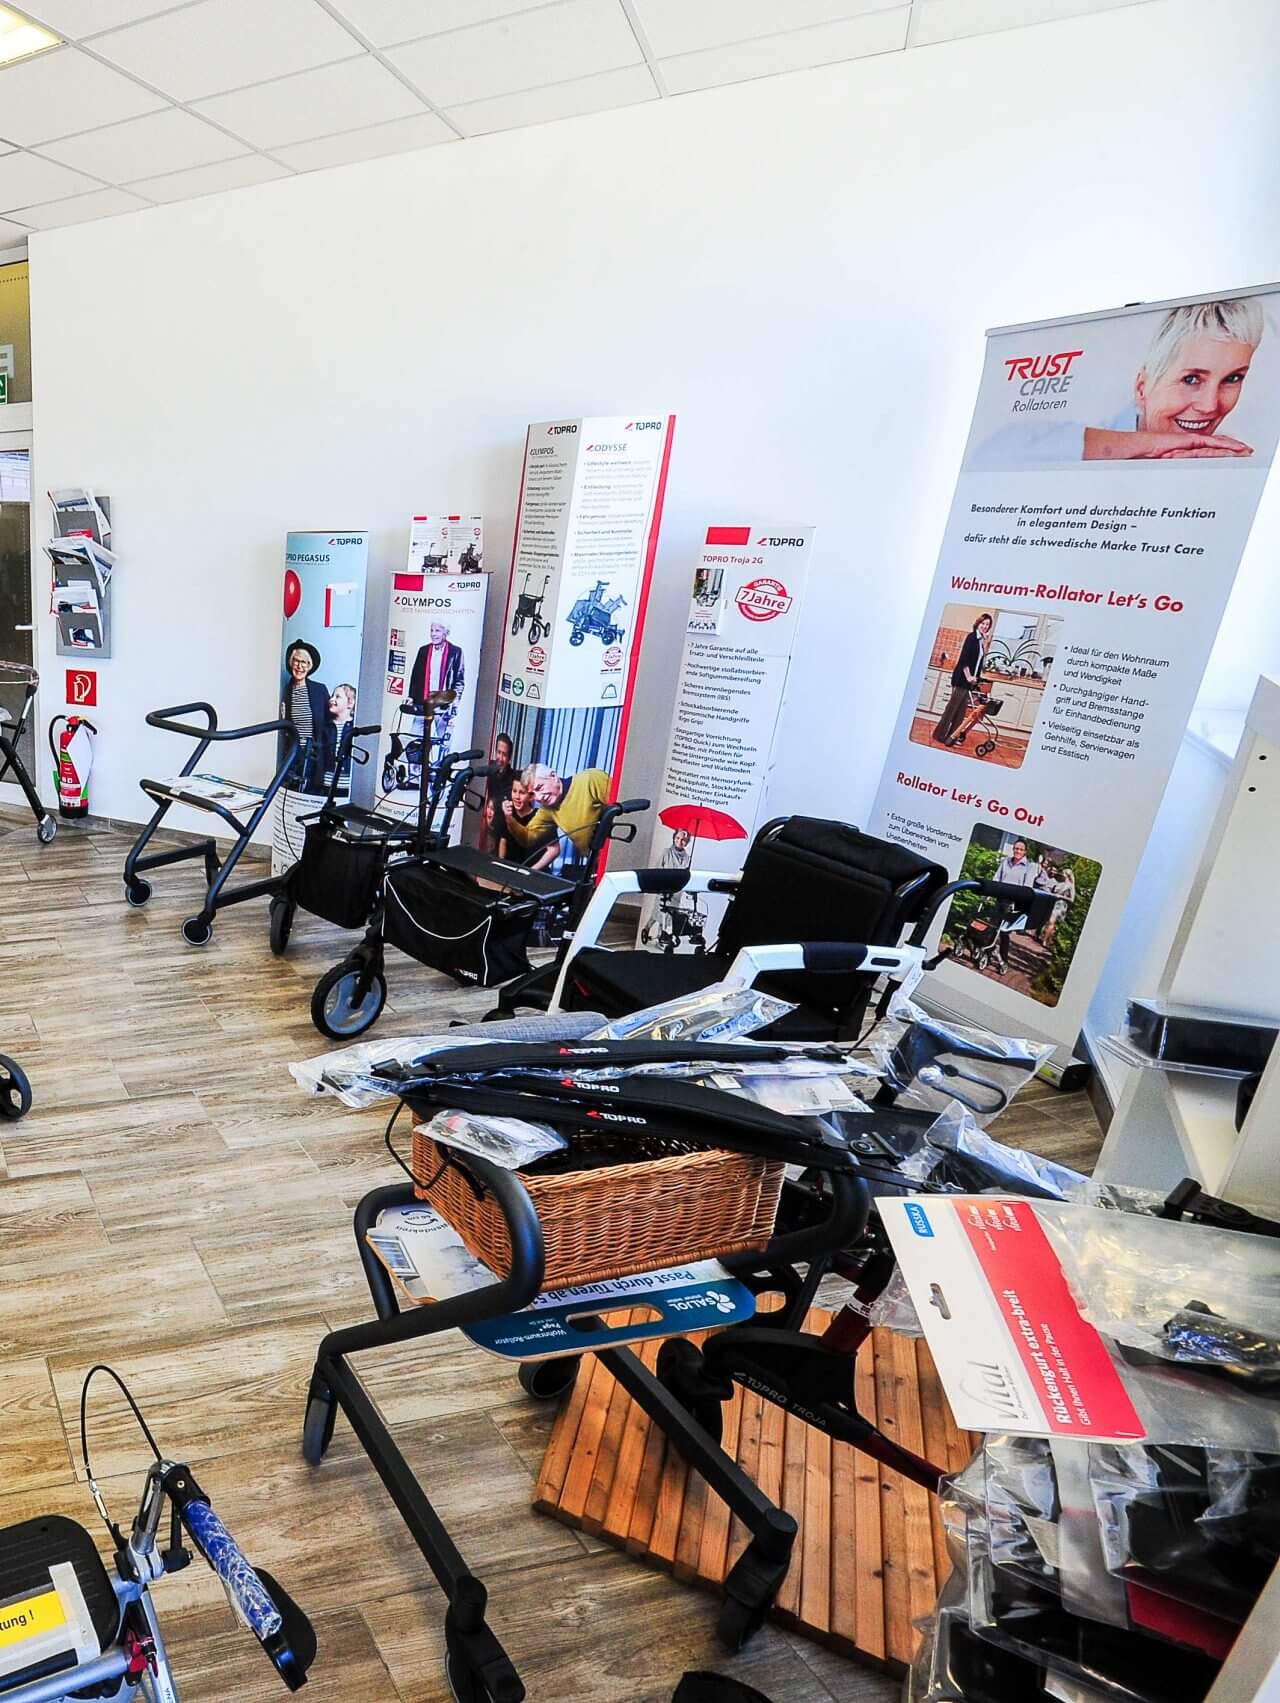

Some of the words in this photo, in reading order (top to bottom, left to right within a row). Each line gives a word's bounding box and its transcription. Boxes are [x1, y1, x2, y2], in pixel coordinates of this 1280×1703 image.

[1005, 351, 1083, 381] TRUST
[1019, 376, 1073, 396] CARE
[1012, 398, 1067, 413] Rollatoren
[554, 425, 577, 434] TOPRO
[635, 422, 662, 431] TOPRO
[971, 504, 1018, 516] Besonderer
[1020, 503, 1062, 516] Komfort
[1065, 505, 1086, 516] und
[1090, 505, 1158, 519] durchdachte
[1161, 508, 1216, 520] Funktion
[1017, 518, 1026, 527] in
[1029, 519, 1087, 532] elegantem
[1090, 521, 1127, 533] Design
[768, 538, 804, 547] TOPRO
[964, 532, 986, 545] dafür
[989, 535, 1009, 545] steht
[1011, 536, 1027, 547] die
[1030, 536, 1097, 551] schwedische
[1101, 540, 1136, 553] Marke
[1141, 543, 1170, 554] Trust
[1173, 544, 1204, 556] Care
[703, 555, 728, 563] TOPRO
[401, 596, 452, 607] OLYMPOS
[951, 575, 1103, 605] Wohnraum-Rollator
[1154, 595, 1184, 614] Go
[1070, 645, 1089, 655] Ideal
[1091, 648, 1102, 657] für
[1103, 651, 1119, 661] den
[1121, 652, 1169, 668] Wohnraum
[1067, 658, 1089, 668] durch
[1091, 660, 1130, 675] kompakte
[1132, 669, 1158, 679] Maße
[1064, 670, 1079, 678] und
[1080, 672, 1122, 686] Wendigkeit
[1059, 683, 1119, 702] Durchgängiger
[1121, 695, 1150, 707] Hand-
[1055, 696, 1071, 705] griff
[1072, 699, 1087, 708] und
[1088, 702, 1144, 720] Bremsstange
[716, 713, 750, 723] Handgriffe
[1053, 706, 1064, 716] für
[1065, 708, 1141, 733] Einhandbedienung
[1048, 721, 1081, 737] Vielseitig
[1083, 729, 1125, 745] einsetzbar
[1126, 739, 1140, 748] als
[1041, 744, 1056, 753] und
[1058, 749, 1089, 761] Esstisch
[1044, 732, 1078, 747] Gehhilfe,
[1079, 738, 1135, 760] Servierwagen
[712, 782, 747, 793] Stockhalter
[896, 771, 949, 798] Rollator
[987, 801, 1009, 817] Go
[1014, 807, 1044, 828] Out
[891, 813, 906, 824] Extra
[573, 1081, 619, 1092] TOPRO
[600, 1112, 647, 1124] TOPRO
[907, 1205, 930, 1235] RUSSKA
[614, 1276, 653, 1290] durch
[654, 1270, 696, 1284] Passt
[547, 1289, 568, 1301] ab
[569, 1281, 614, 1297] Türen
[1002, 1289, 1040, 1350] extra-breit
[1040, 1323, 1055, 1345] Pause
[1050, 1345, 1062, 1359] der
[1055, 1358, 1067, 1373] in
[1060, 1367, 1072, 1385] Halt
[1030, 1351, 1073, 1424] Rückengurt
[1068, 1384, 1083, 1406] Ihnen
[748, 1376, 788, 1404] TOPRO
[792, 1403, 827, 1426] TROJA
[1077, 1407, 1091, 1425] Gibt
[28, 1609, 35, 1620] !
